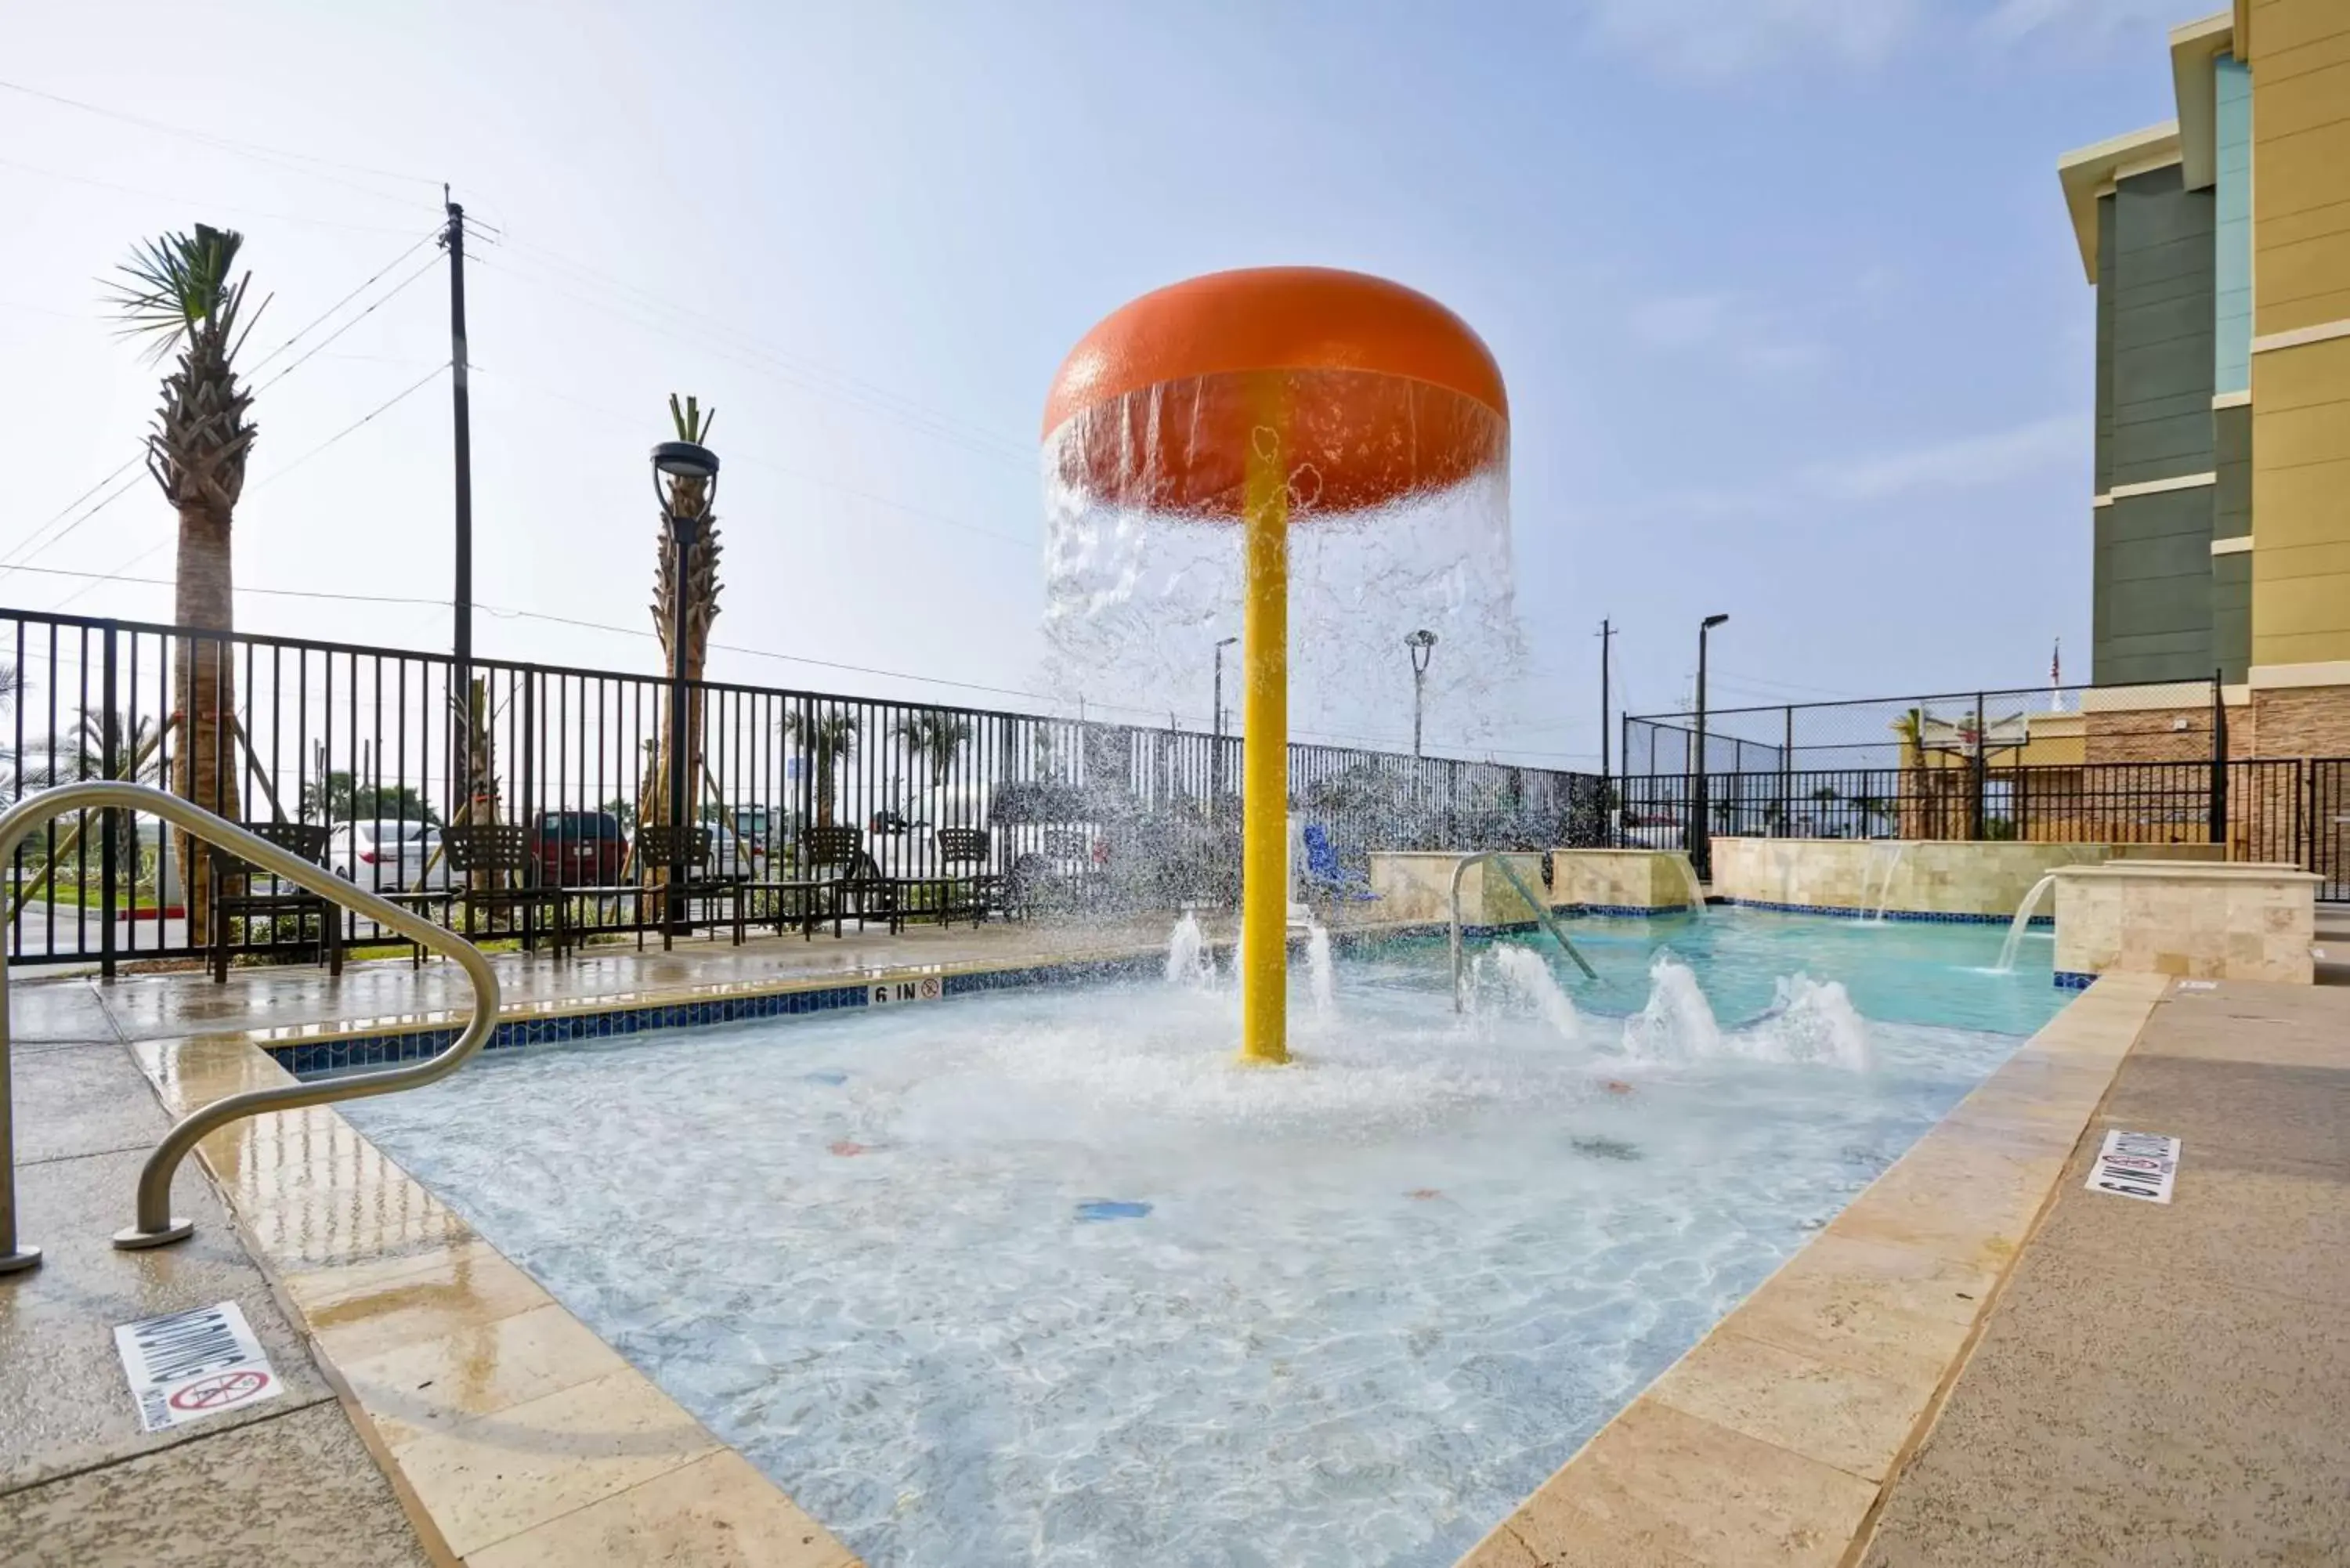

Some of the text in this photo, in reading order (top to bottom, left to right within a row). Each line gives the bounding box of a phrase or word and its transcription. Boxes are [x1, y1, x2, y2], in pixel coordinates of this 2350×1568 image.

[875, 982, 916, 1003] 6 IN
[2102, 1165, 2163, 1185] IN
[2099, 1182, 2159, 1197] 6
[131, 1306, 247, 1383] NO DIVING
